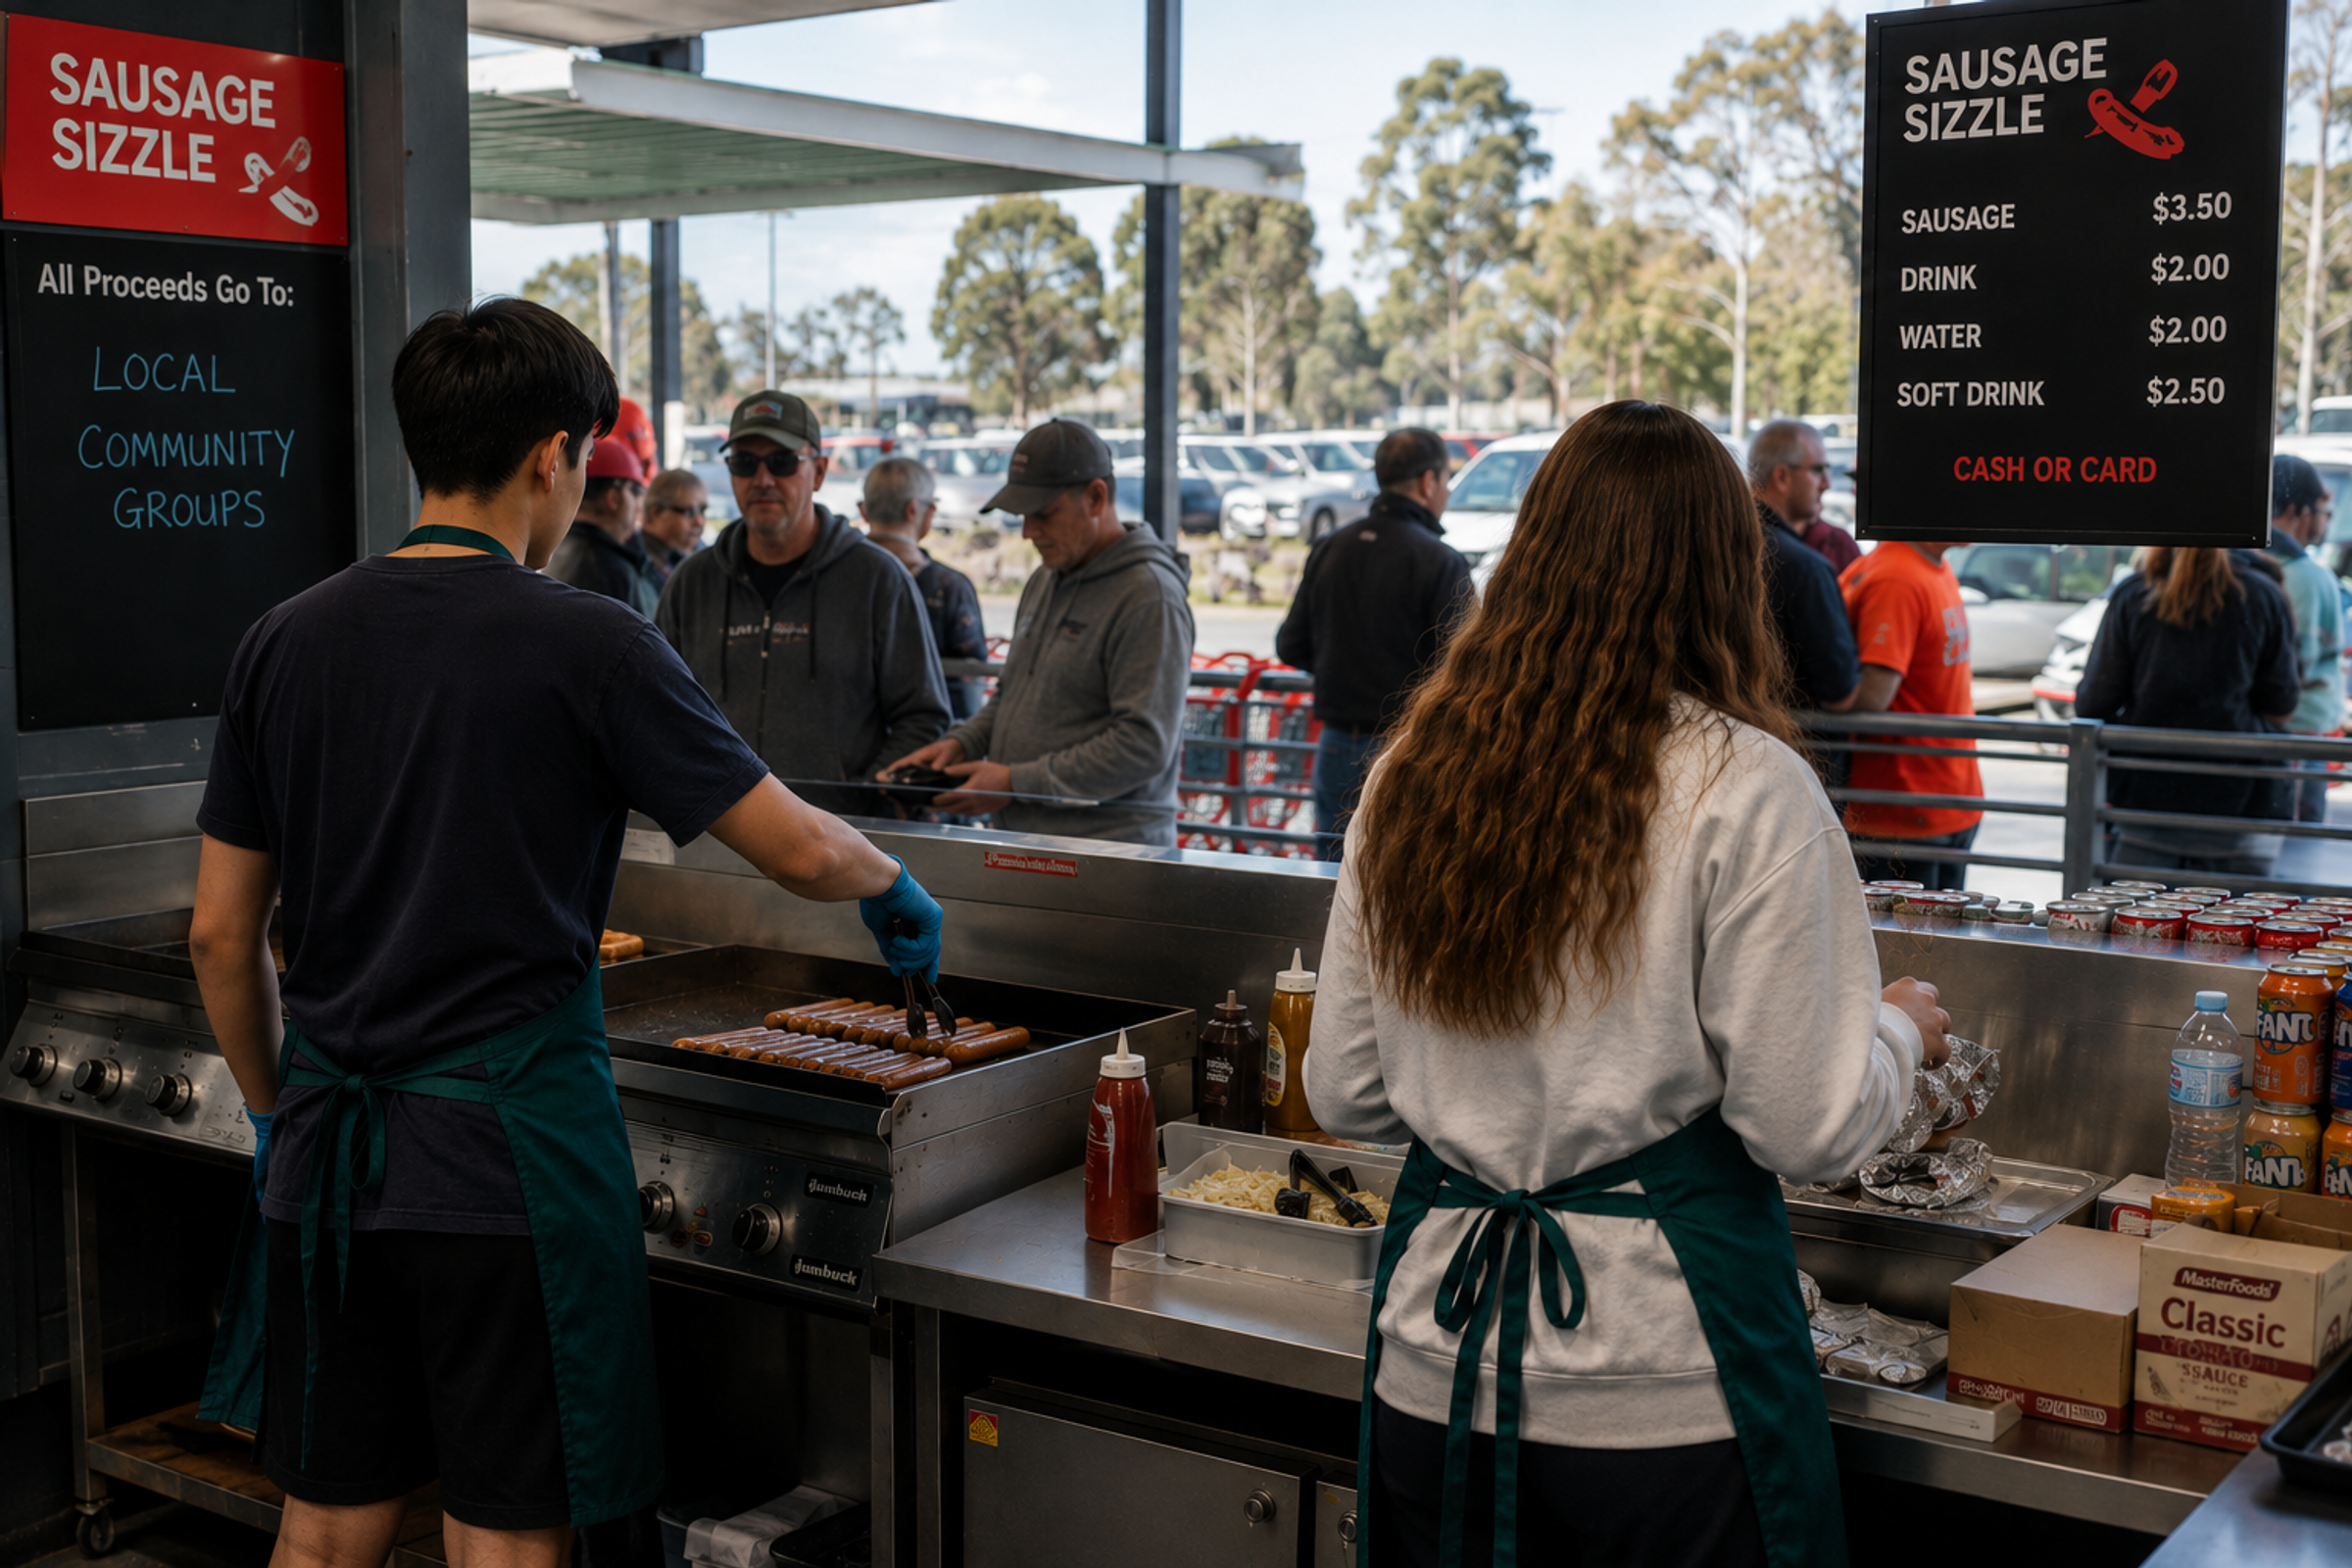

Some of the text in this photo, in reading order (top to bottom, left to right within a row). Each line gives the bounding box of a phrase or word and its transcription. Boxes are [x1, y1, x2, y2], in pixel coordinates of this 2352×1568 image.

[1905, 38, 2107, 94] SAUSAGE
[50, 52, 276, 128] SAUSAGE
[1903, 94, 2045, 143] SIZZLE
[52, 119, 217, 183] SIZZLE
[1901, 191, 2232, 234] SAUSAGE $3.50
[37, 263, 294, 307] All Proceeds Go To:
[1901, 253, 2230, 292] DRINK $2.00
[1899, 315, 2228, 350] WATER $2.00
[93, 346, 236, 394] LOCAL
[1896, 376, 2226, 408] SOFT DRINK $2.50
[77, 423, 295, 478] COMMUNITY
[1953, 456, 2157, 483] CASH OR CARD
[113, 487, 266, 529] GROUPS
[2161, 1298, 2286, 1348] Classic
